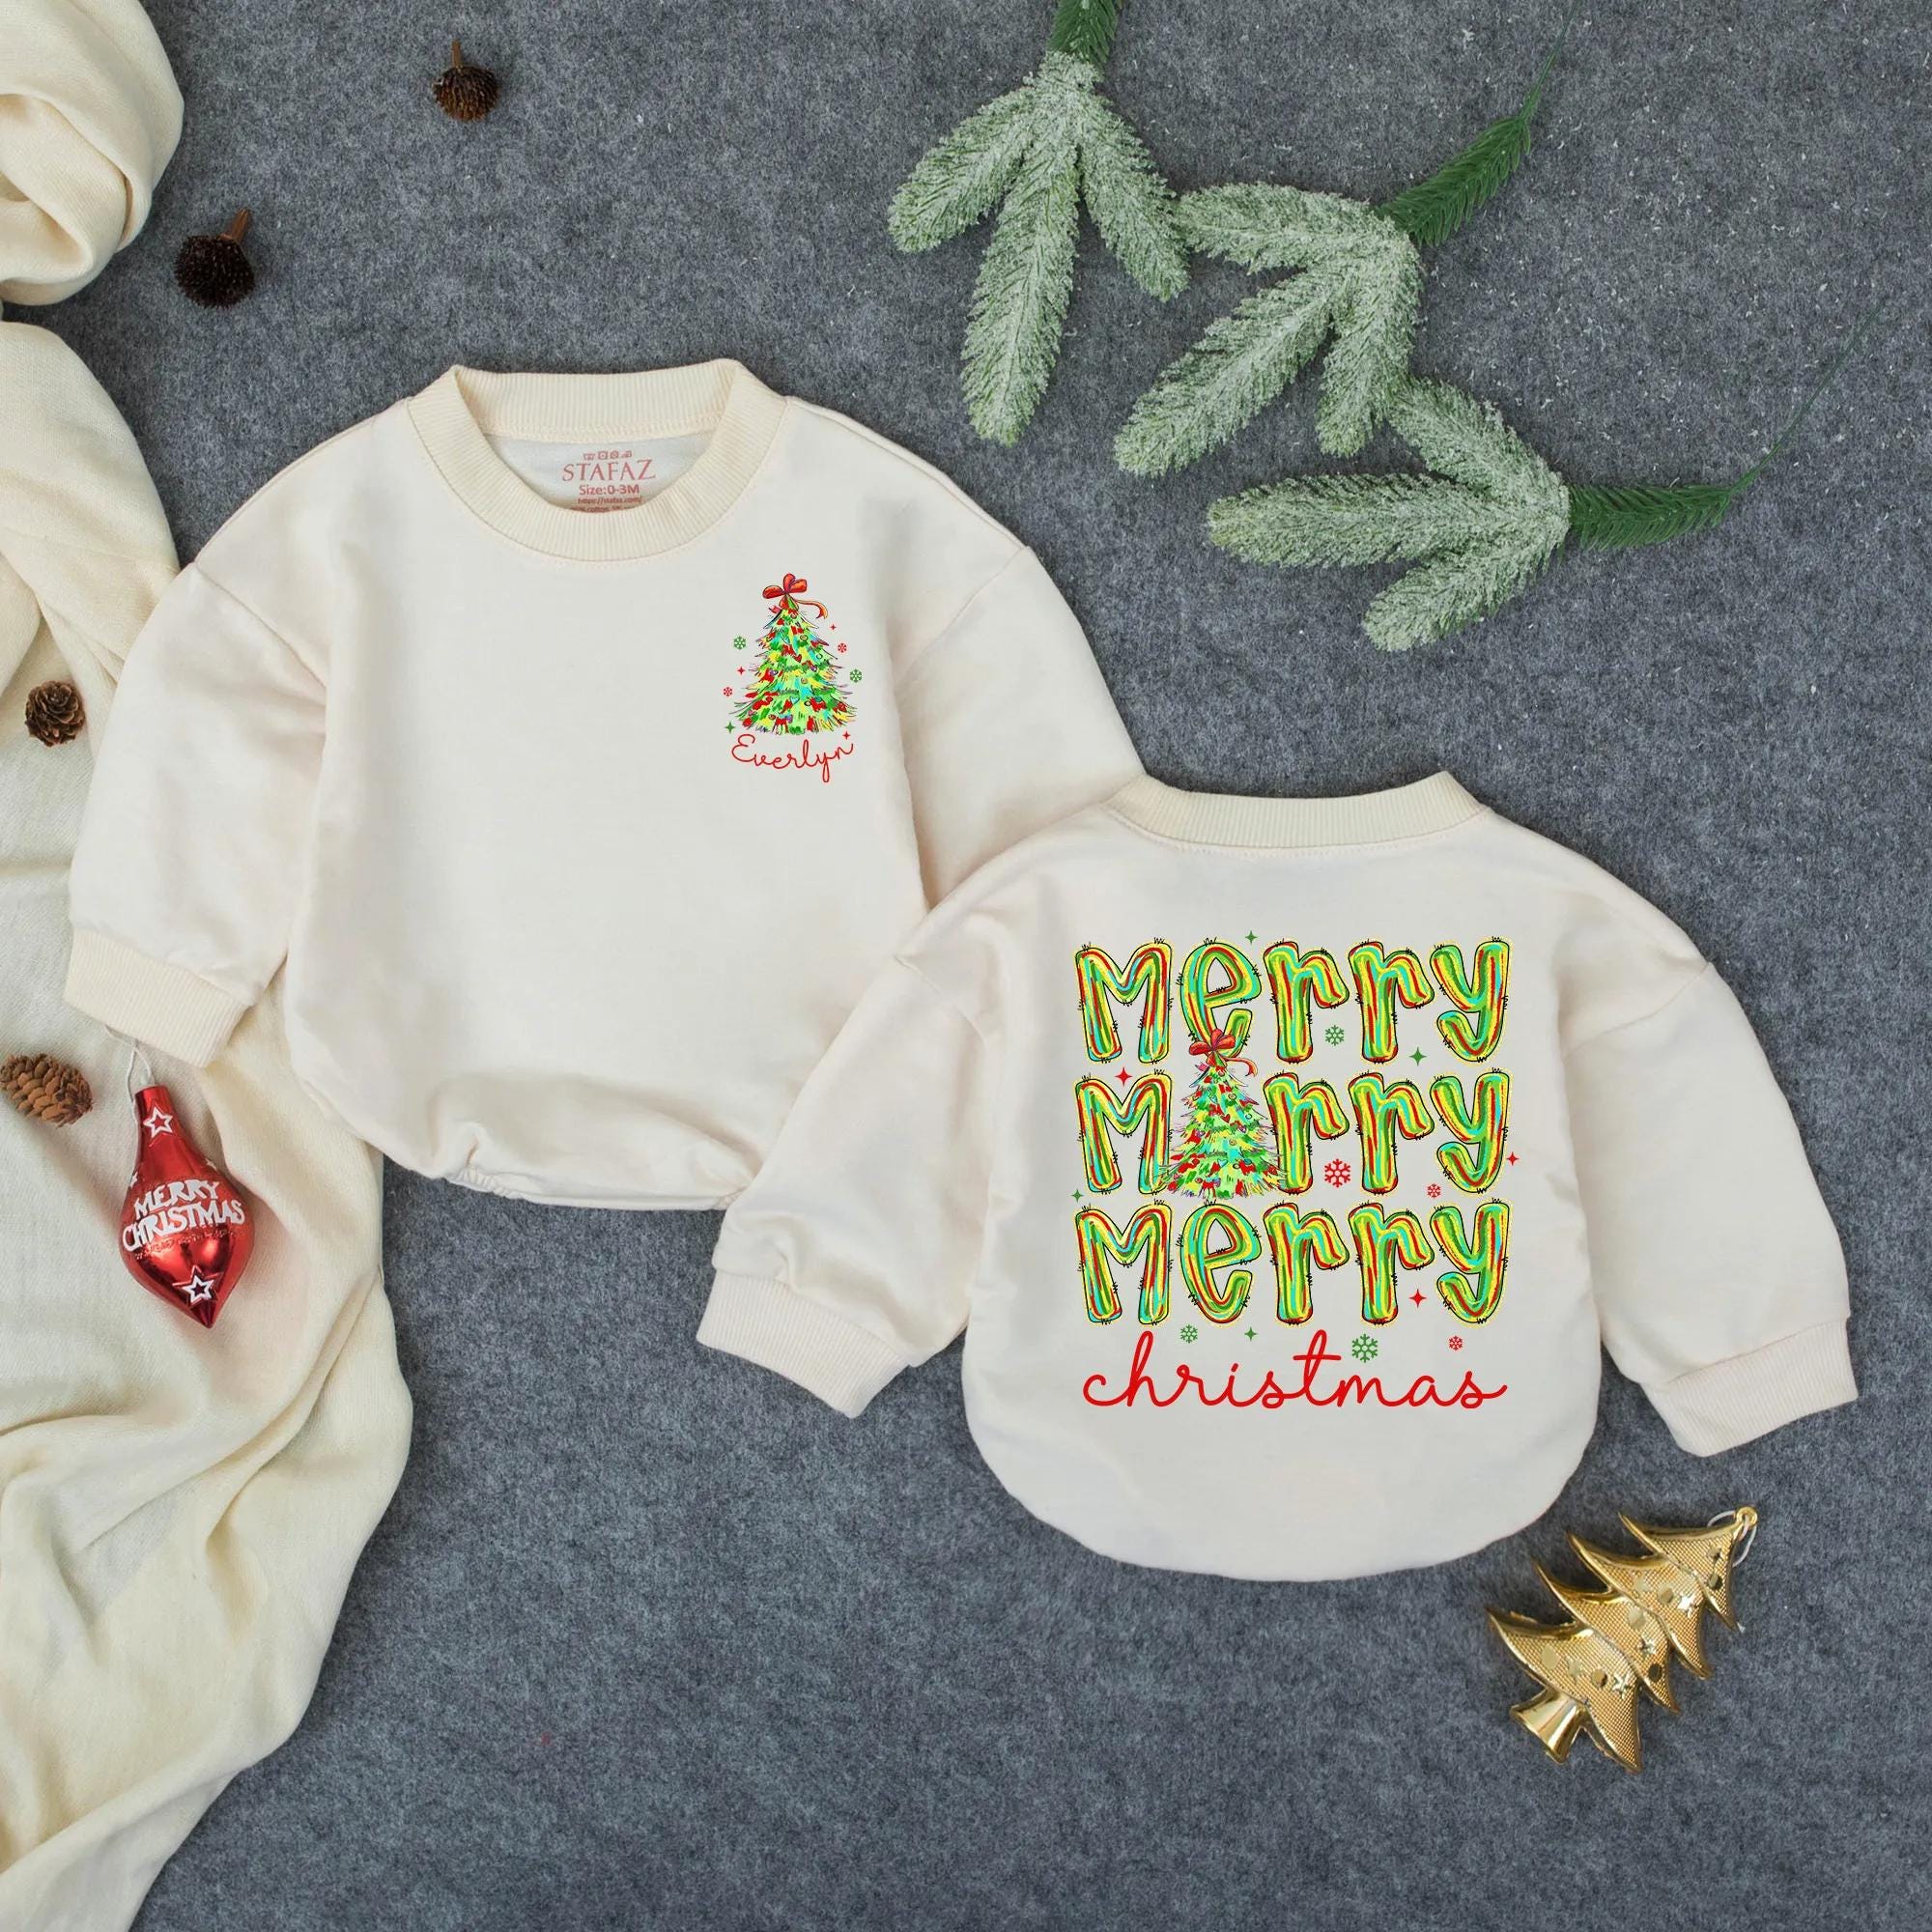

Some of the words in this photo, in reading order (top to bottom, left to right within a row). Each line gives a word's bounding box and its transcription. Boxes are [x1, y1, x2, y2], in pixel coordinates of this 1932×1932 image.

[562, 459, 656, 482] STAFAZ
[579, 484, 639, 496] Size:0-3M
[731, 733, 854, 783] Everlyn
[1074, 937, 1510, 1064] Merry
[1074, 1068, 1510, 1195] Mrry
[122, 1199, 245, 1252] CHRISTMAS
[133, 1179, 220, 1221] MERRY
[1074, 1199, 1510, 1325] Merry
[1083, 1329, 1508, 1409] christmas
